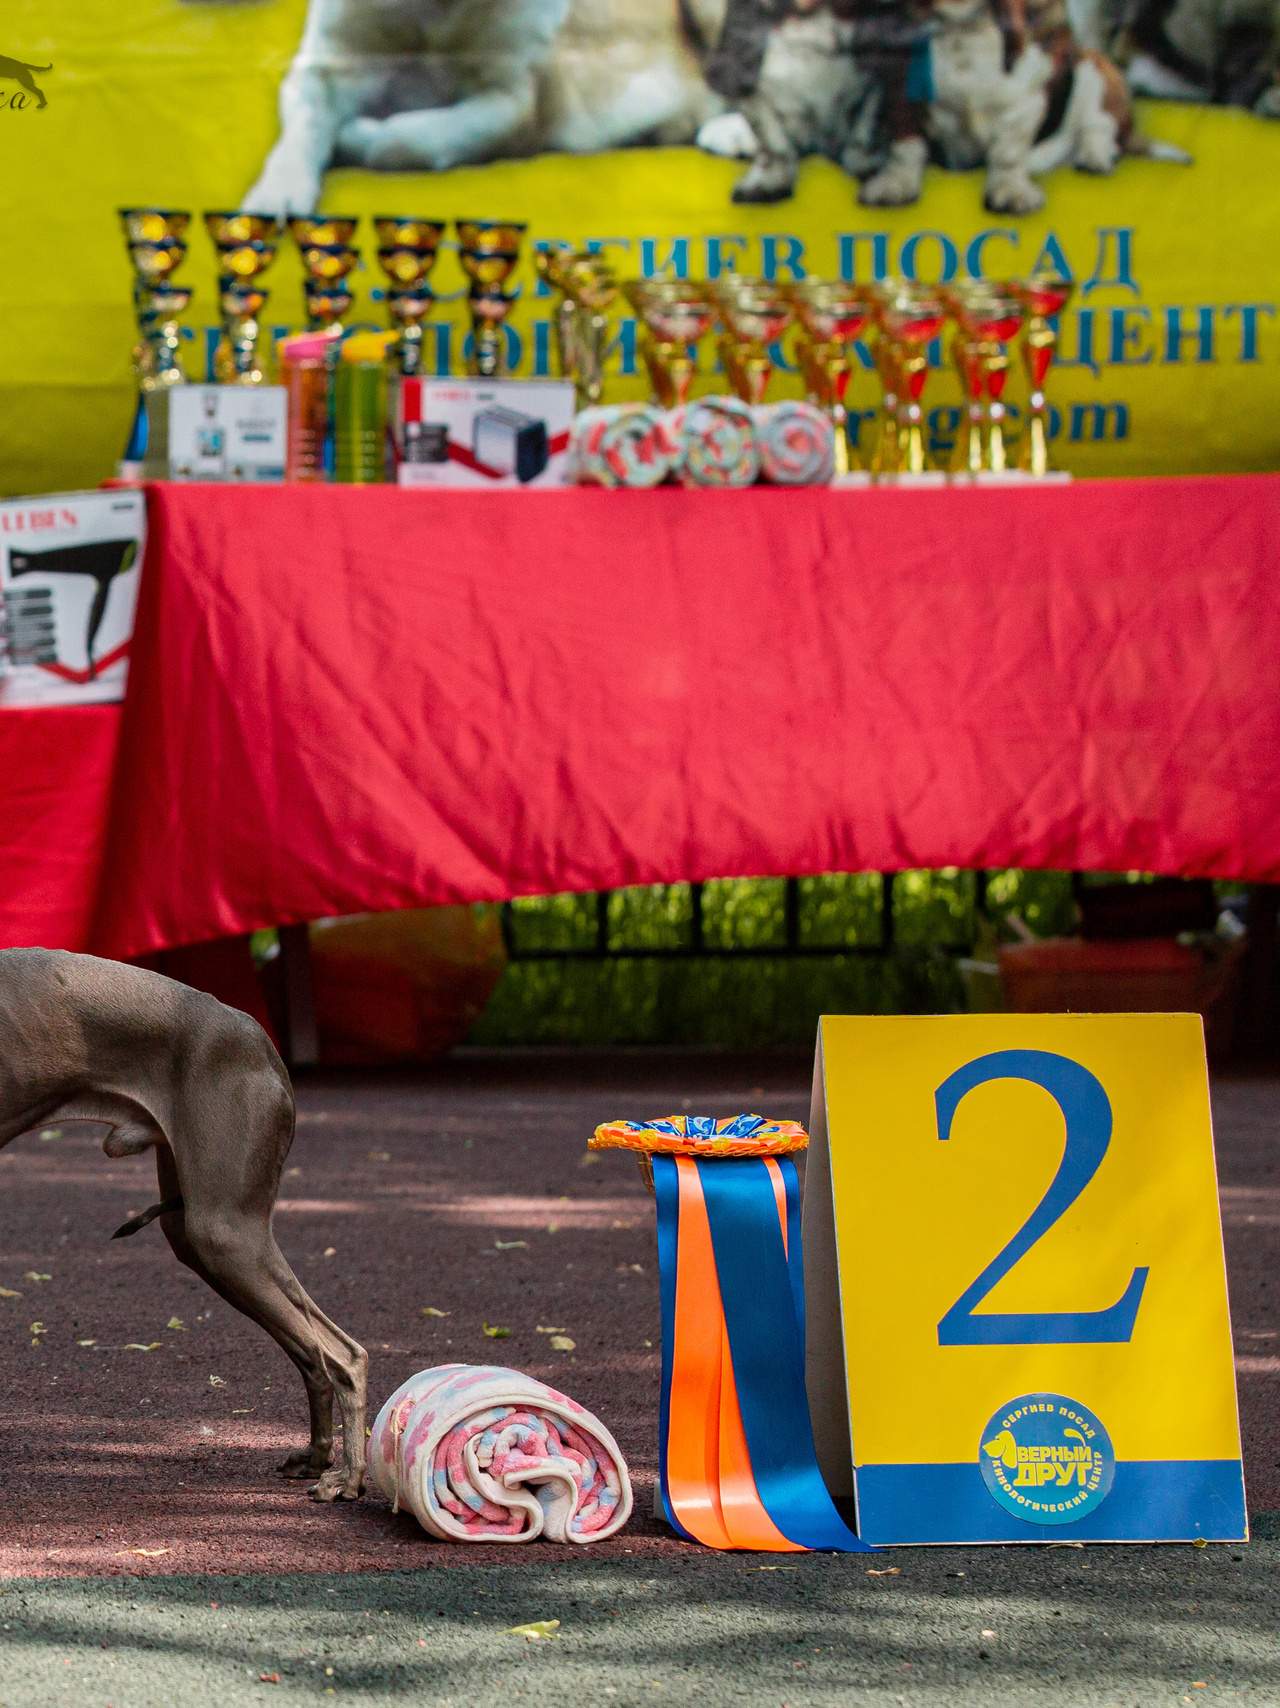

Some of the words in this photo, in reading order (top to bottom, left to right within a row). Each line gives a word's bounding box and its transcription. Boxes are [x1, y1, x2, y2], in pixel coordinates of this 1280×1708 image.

[836, 225, 1141, 298] ПОСАД
[934, 1048, 1150, 1346] 2
[1002, 1403, 1054, 1428] СЕРГИЕВ
[1059, 1406, 1096, 1439] ПОСАД
[1012, 1462, 1093, 1486] ДРУГ
[1016, 1446, 1092, 1462] ВЕРНЫЙ
[992, 1459, 1089, 1512] КИНОЛОГИЧЕСКИЙ
[1086, 1451, 1103, 1491] ЦЕНТР
